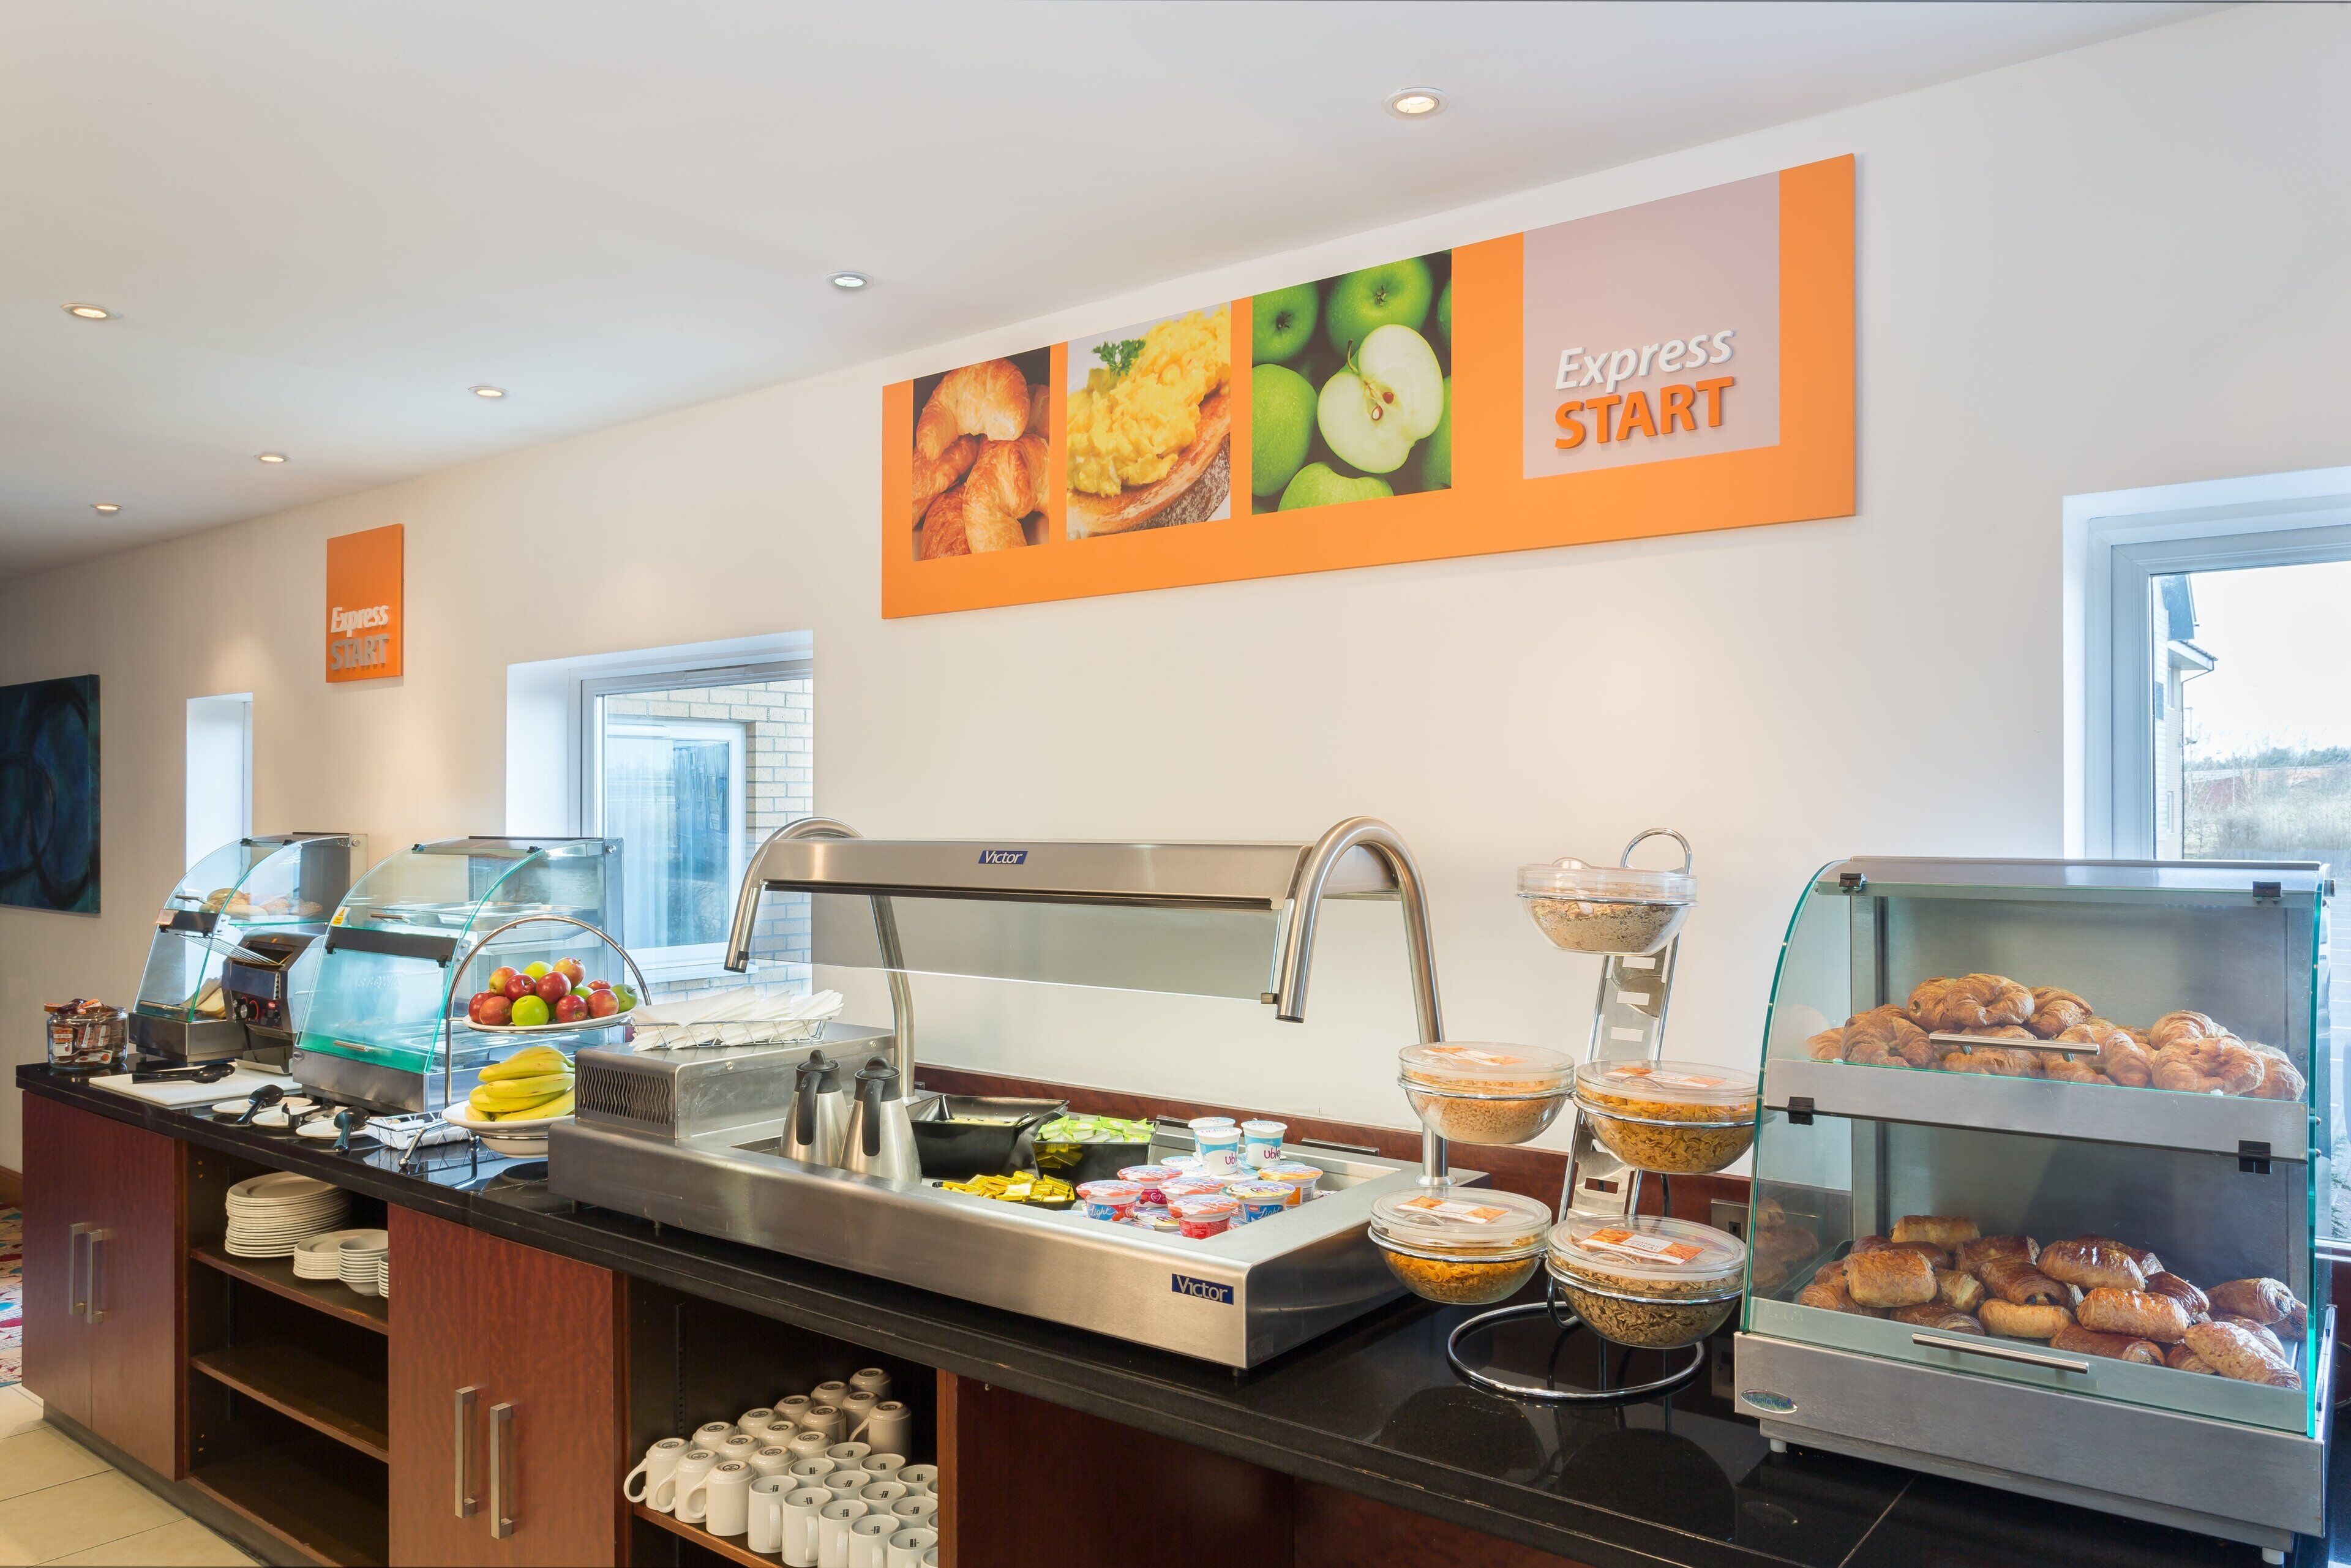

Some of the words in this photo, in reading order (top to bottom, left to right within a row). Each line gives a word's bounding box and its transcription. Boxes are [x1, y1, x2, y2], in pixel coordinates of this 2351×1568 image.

[1555, 329, 1734, 393] Express
[1554, 376, 1736, 449] START
[331, 605, 389, 637] Express
[331, 633, 389, 670] START
[985, 850, 1023, 864] Victor
[1088, 1205, 1117, 1219] Light
[1176, 1275, 1228, 1302] Victor
